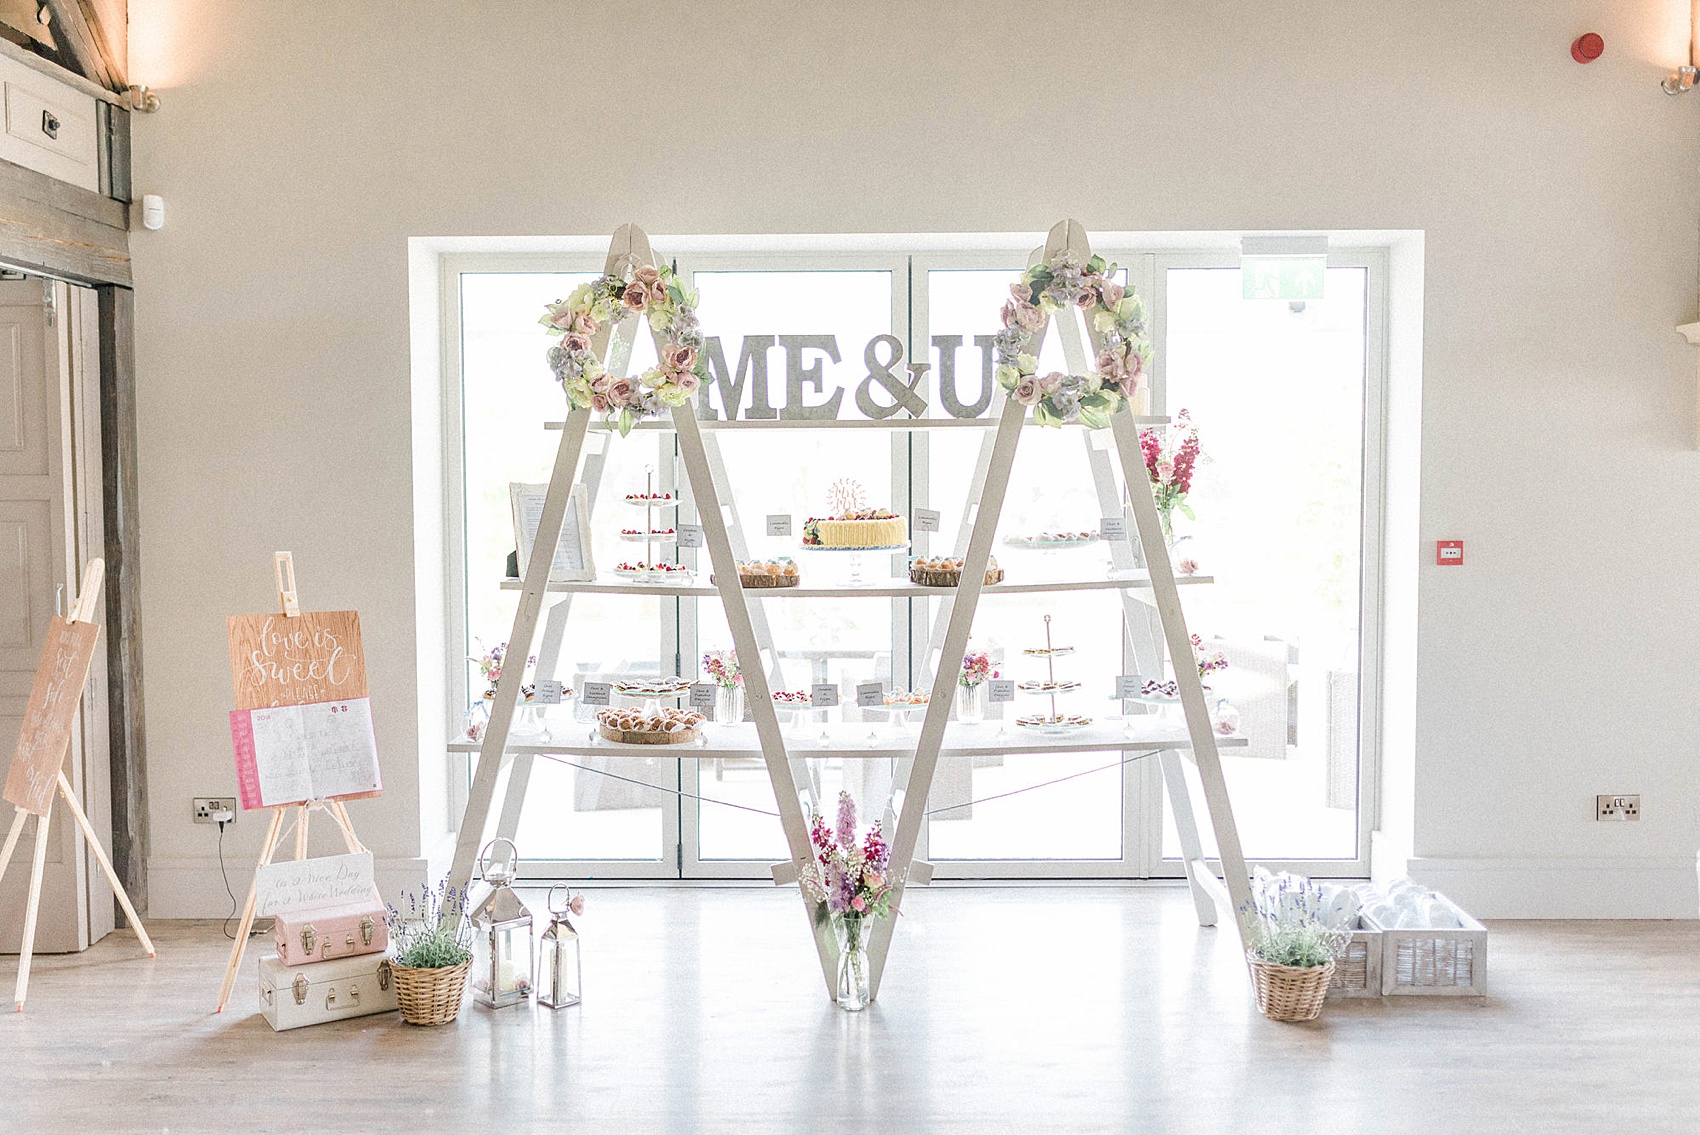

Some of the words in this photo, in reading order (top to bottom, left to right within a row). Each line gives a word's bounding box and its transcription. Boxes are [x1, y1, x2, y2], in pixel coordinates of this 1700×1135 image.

[699, 334, 845, 421] ME
[315, 626, 341, 650] is
[305, 863, 331, 884] Nice
[336, 862, 360, 881] Day
[326, 883, 372, 899] Wedding
